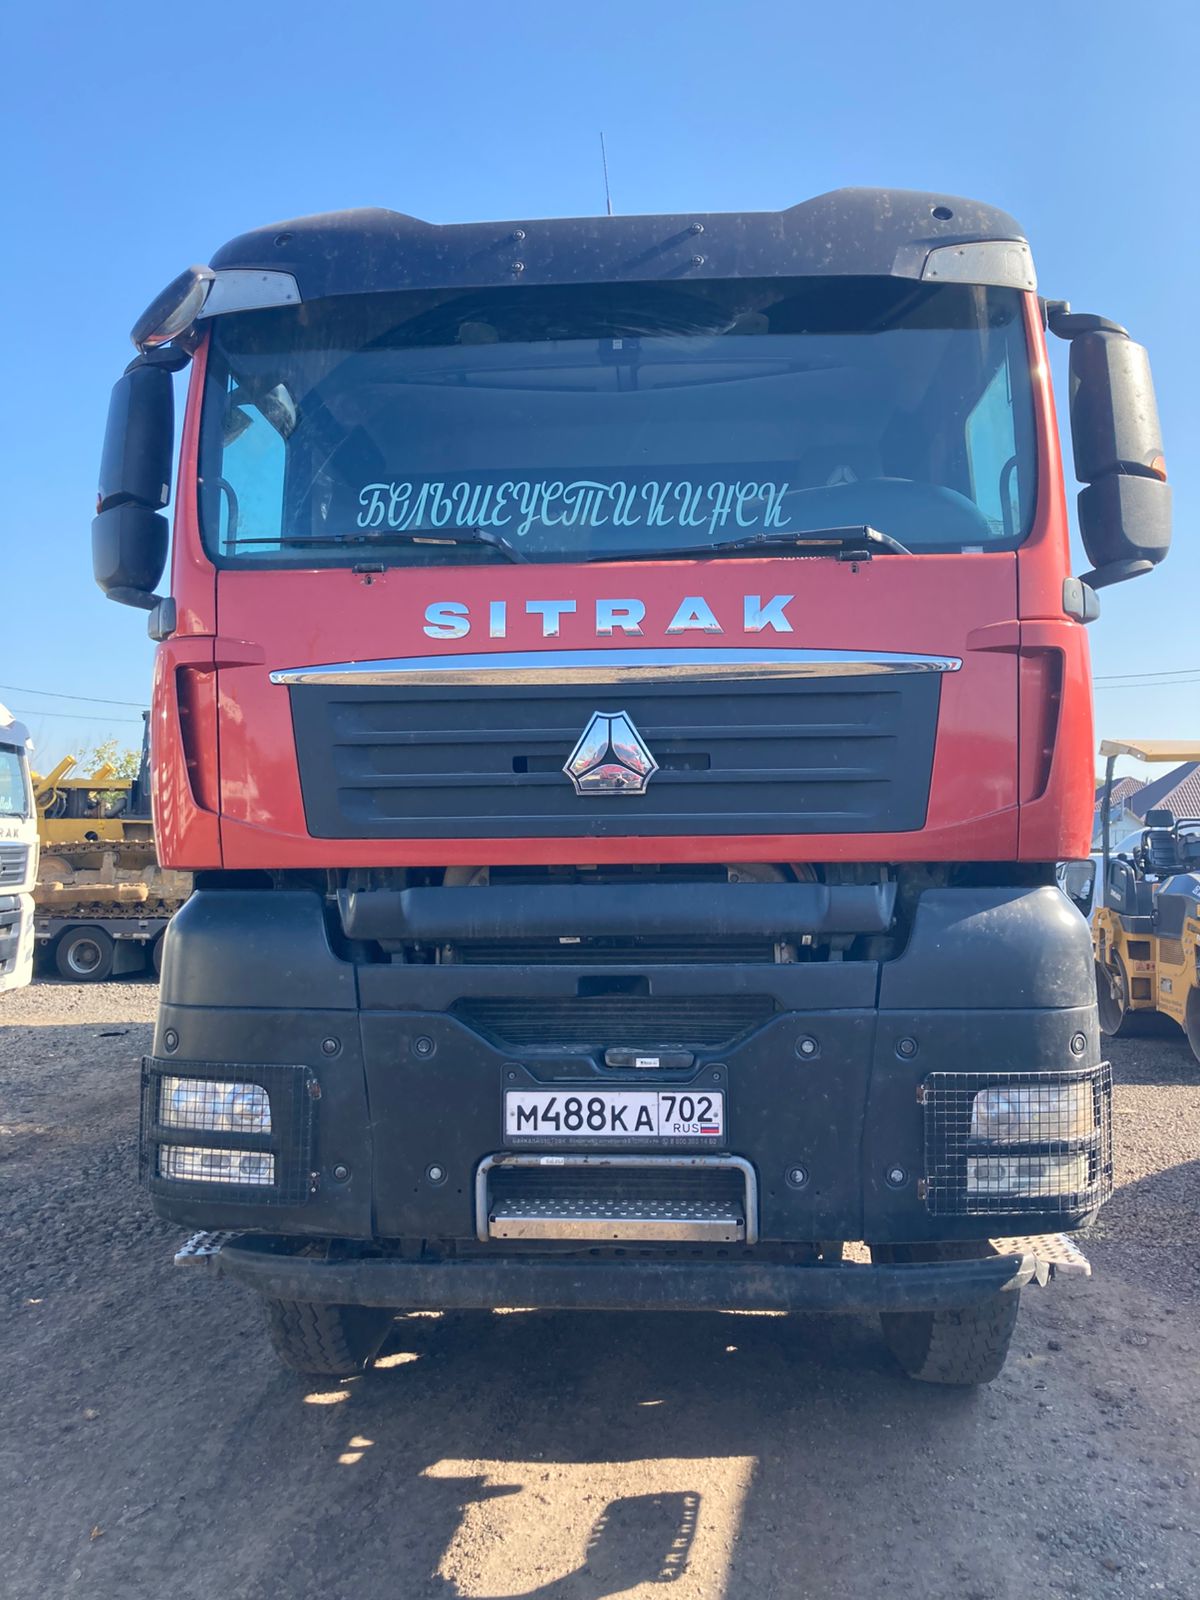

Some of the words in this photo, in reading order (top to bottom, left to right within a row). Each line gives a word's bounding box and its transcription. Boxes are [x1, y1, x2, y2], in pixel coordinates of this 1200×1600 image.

[423, 594, 795, 640] SITRAK
[661, 1096, 713, 1122] 702
[673, 1123, 699, 1133] RUS
